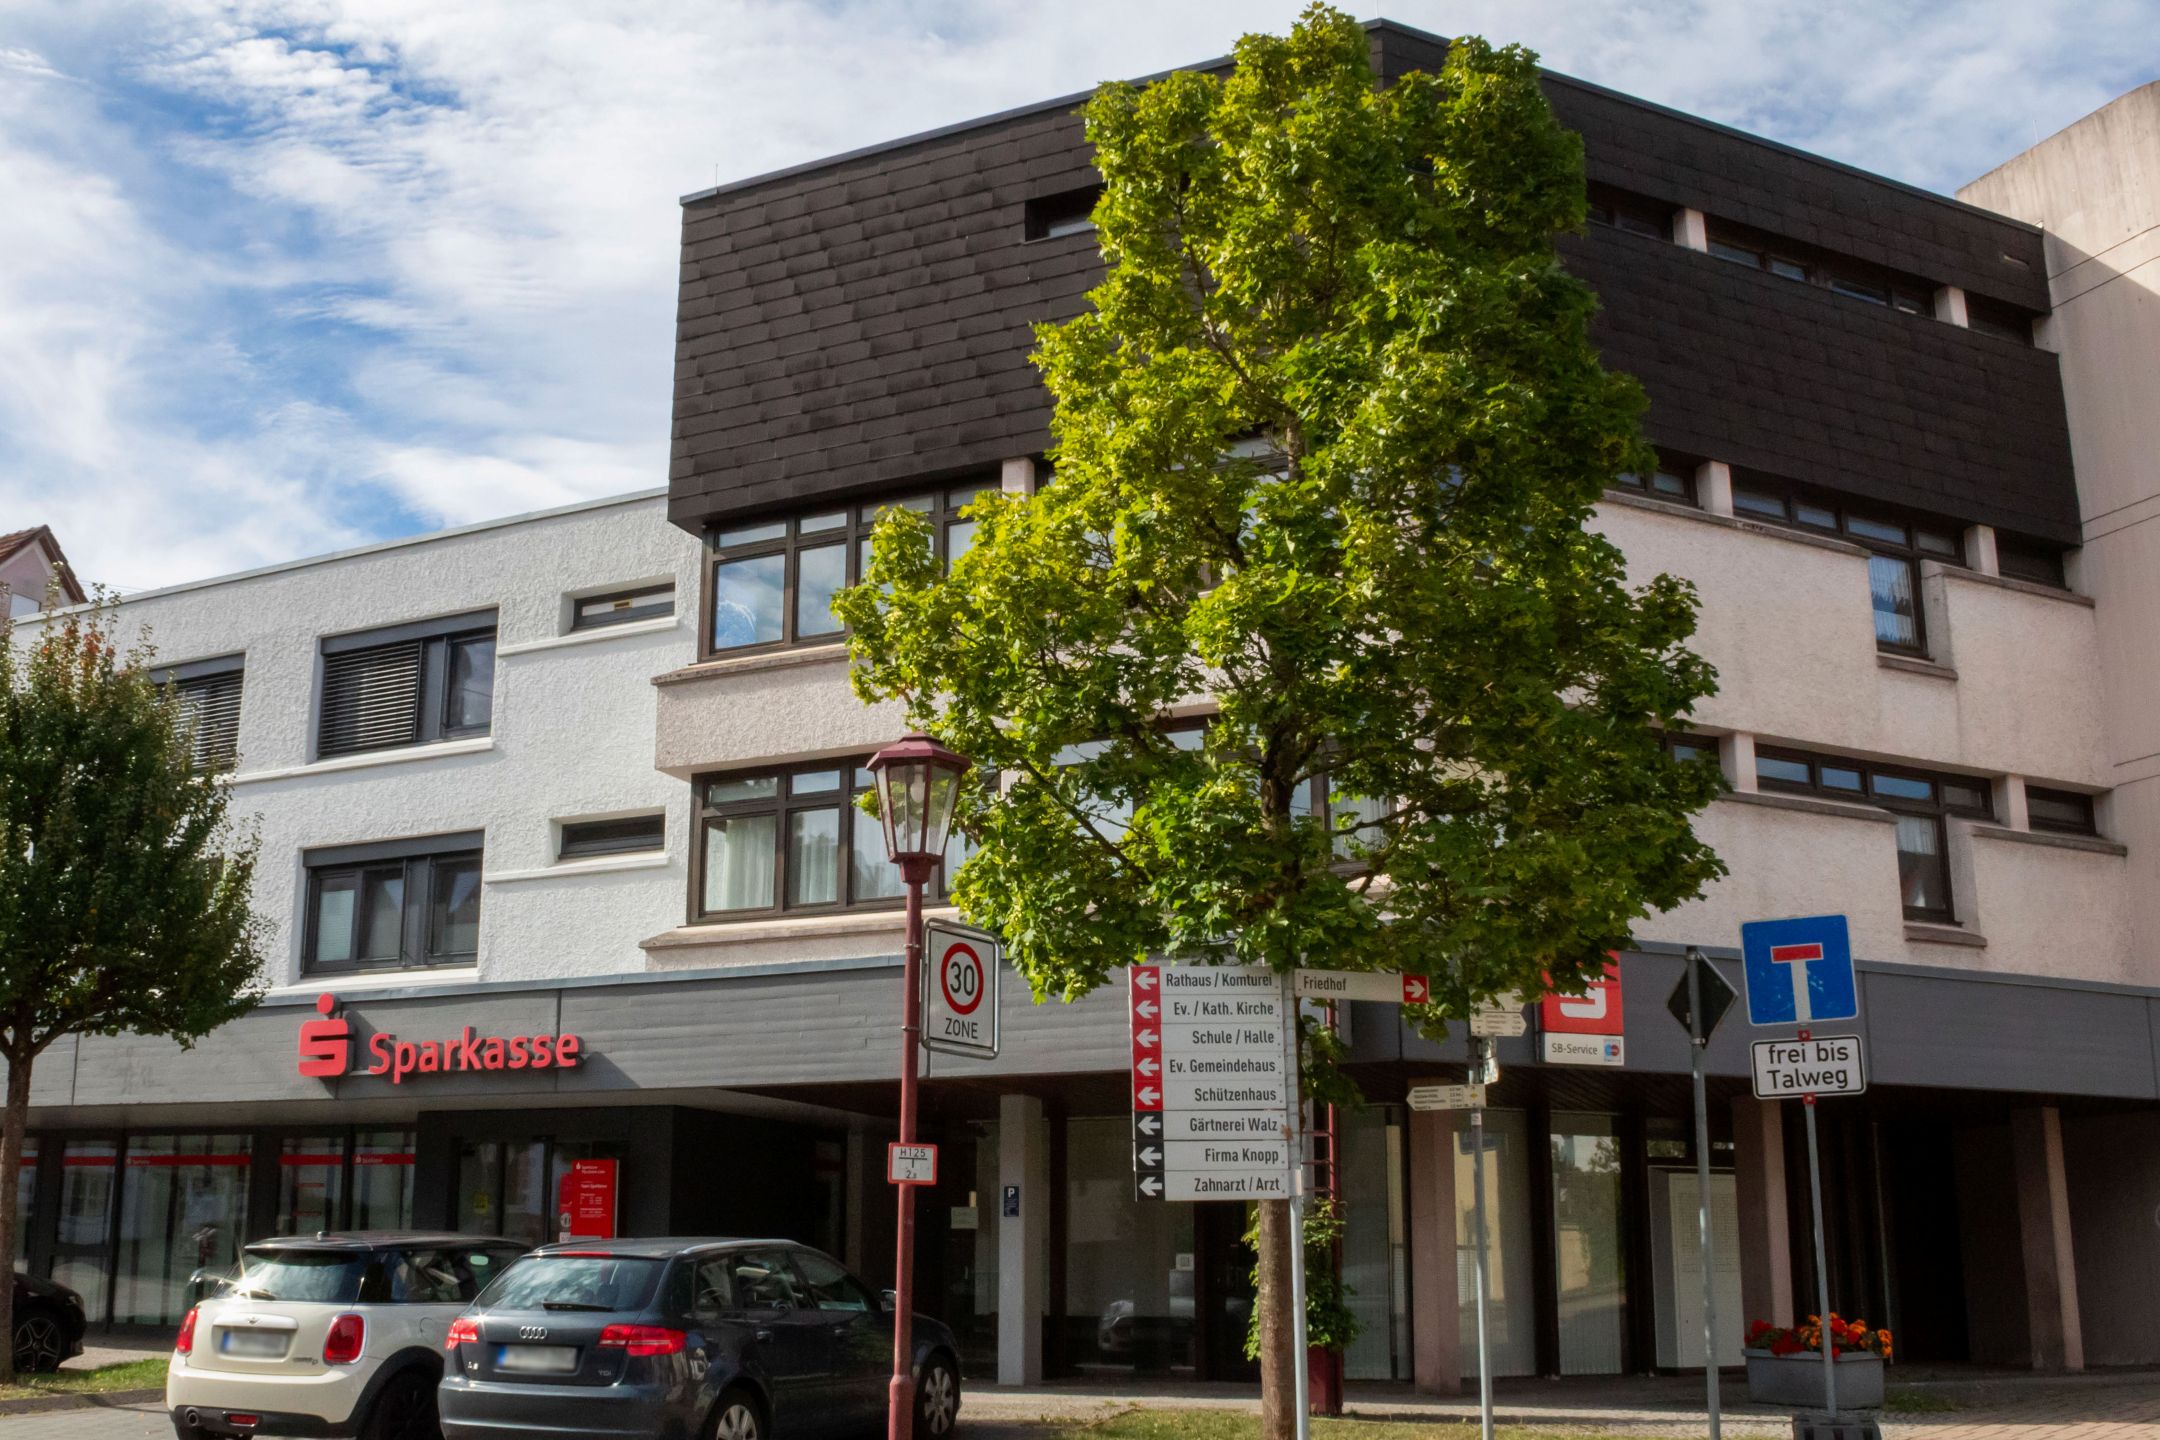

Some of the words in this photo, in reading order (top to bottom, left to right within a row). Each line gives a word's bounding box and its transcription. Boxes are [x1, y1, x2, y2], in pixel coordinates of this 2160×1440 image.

[950, 961, 975, 996] 30
[1166, 973, 1212, 987] Rathaus
[1222, 972, 1272, 987] Komturei
[1303, 975, 1346, 991] Friedhof
[1174, 1002, 1190, 1015] Ev.
[1202, 1002, 1233, 1015] Kath.
[1237, 1001, 1274, 1015] Kirche
[945, 1017, 978, 1039] ZONE
[1193, 1030, 1232, 1044] Schule
[1244, 1030, 1274, 1043] Halle
[369, 1026, 580, 1084] Sparkasse
[1552, 1040, 1598, 1055] SB-Service
[1768, 1043, 1807, 1064] frei
[1816, 1042, 1849, 1062] bis
[1170, 1059, 1186, 1073] Ev.
[1190, 1059, 1276, 1073] Gemeindehaus
[1767, 1068, 1848, 1089] Talweg
[1194, 1088, 1276, 1101] Schützenhaus
[1190, 1117, 1245, 1131] Gärtnerei
[1248, 1118, 1277, 1131] Walz
[1205, 1148, 1239, 1162] Firma
[1242, 1148, 1279, 1164] Knopp
[1194, 1178, 1247, 1192] Zahnarzt
[1256, 1177, 1280, 1191] Arzt
[1008, 1187, 1015, 1198] P
